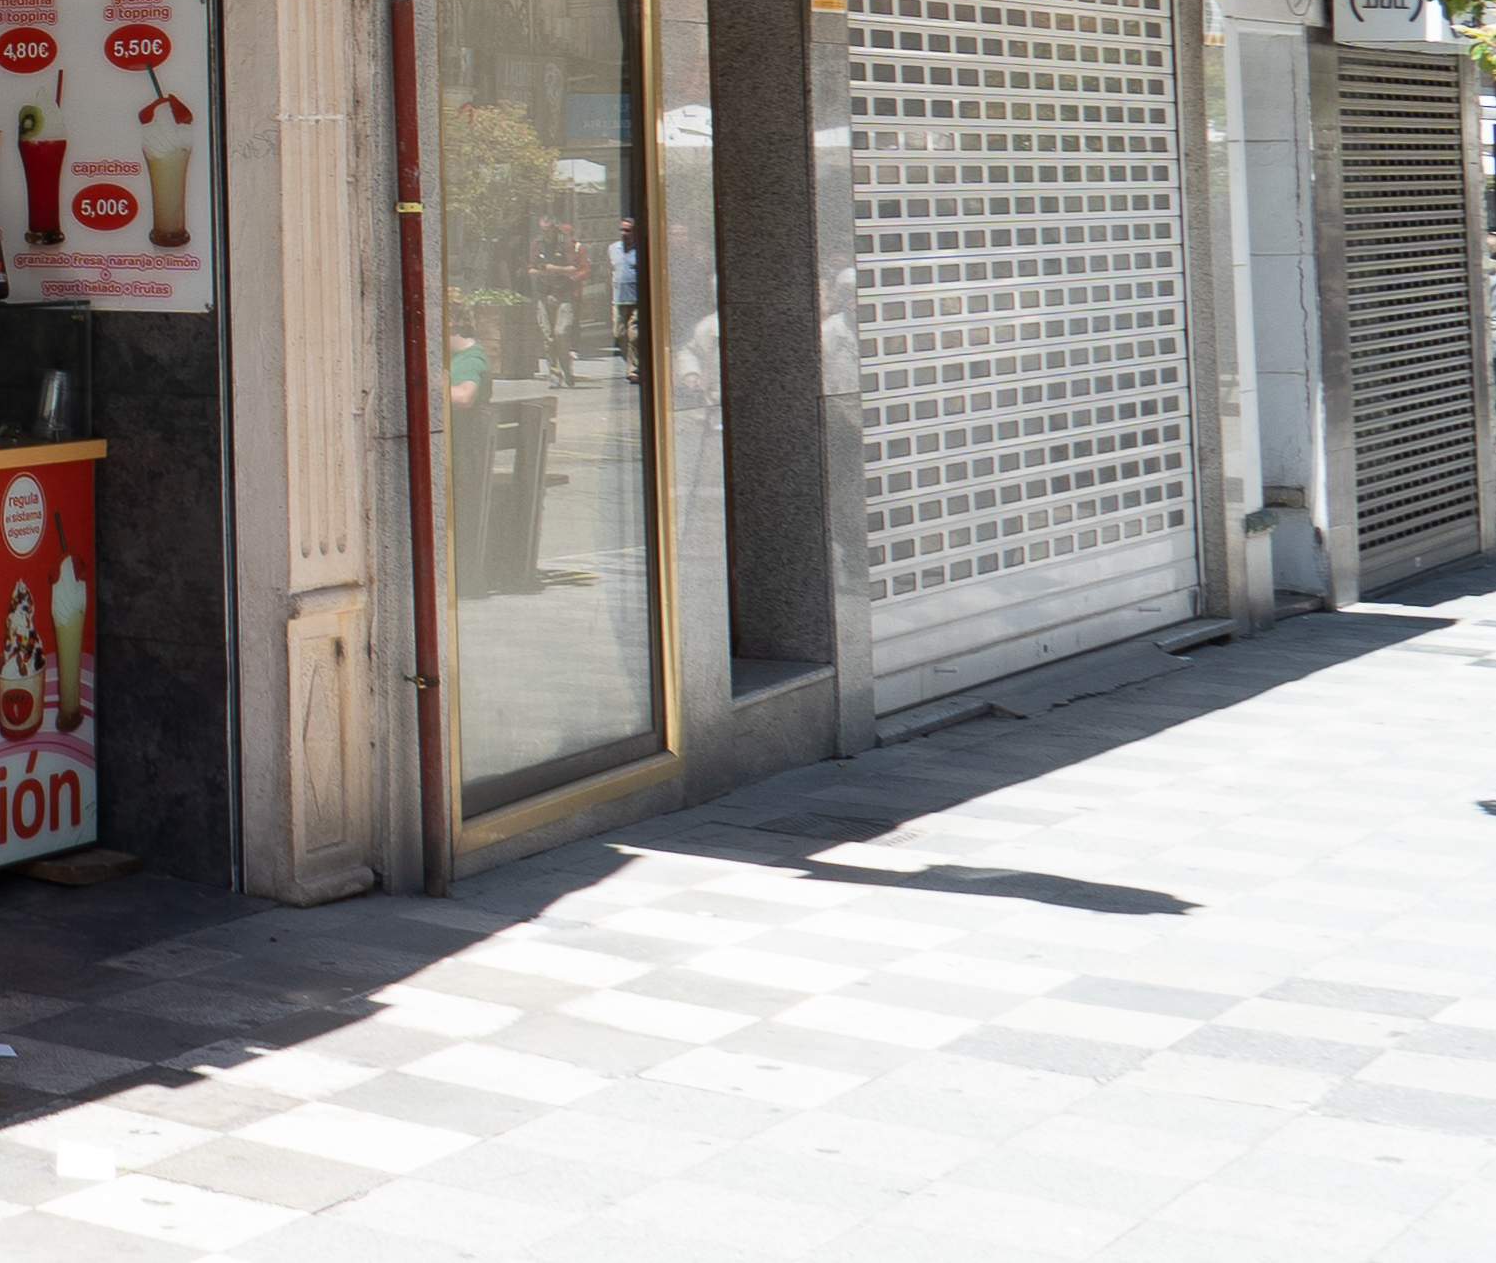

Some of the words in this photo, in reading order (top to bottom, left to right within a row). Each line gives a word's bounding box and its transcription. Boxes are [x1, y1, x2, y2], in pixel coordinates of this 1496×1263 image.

[7, 11, 56, 26] topping
[106, 8, 114, 19] 3
[119, 6, 170, 22] topping
[3, 41, 49, 59] 4,80€
[113, 39, 163, 57] 5,50€
[73, 161, 140, 177] caprichos
[80, 199, 129, 217] 5,00€
[15, 254, 70, 267] granizado
[109, 256, 153, 270] naranja
[8, 491, 40, 508] regula
